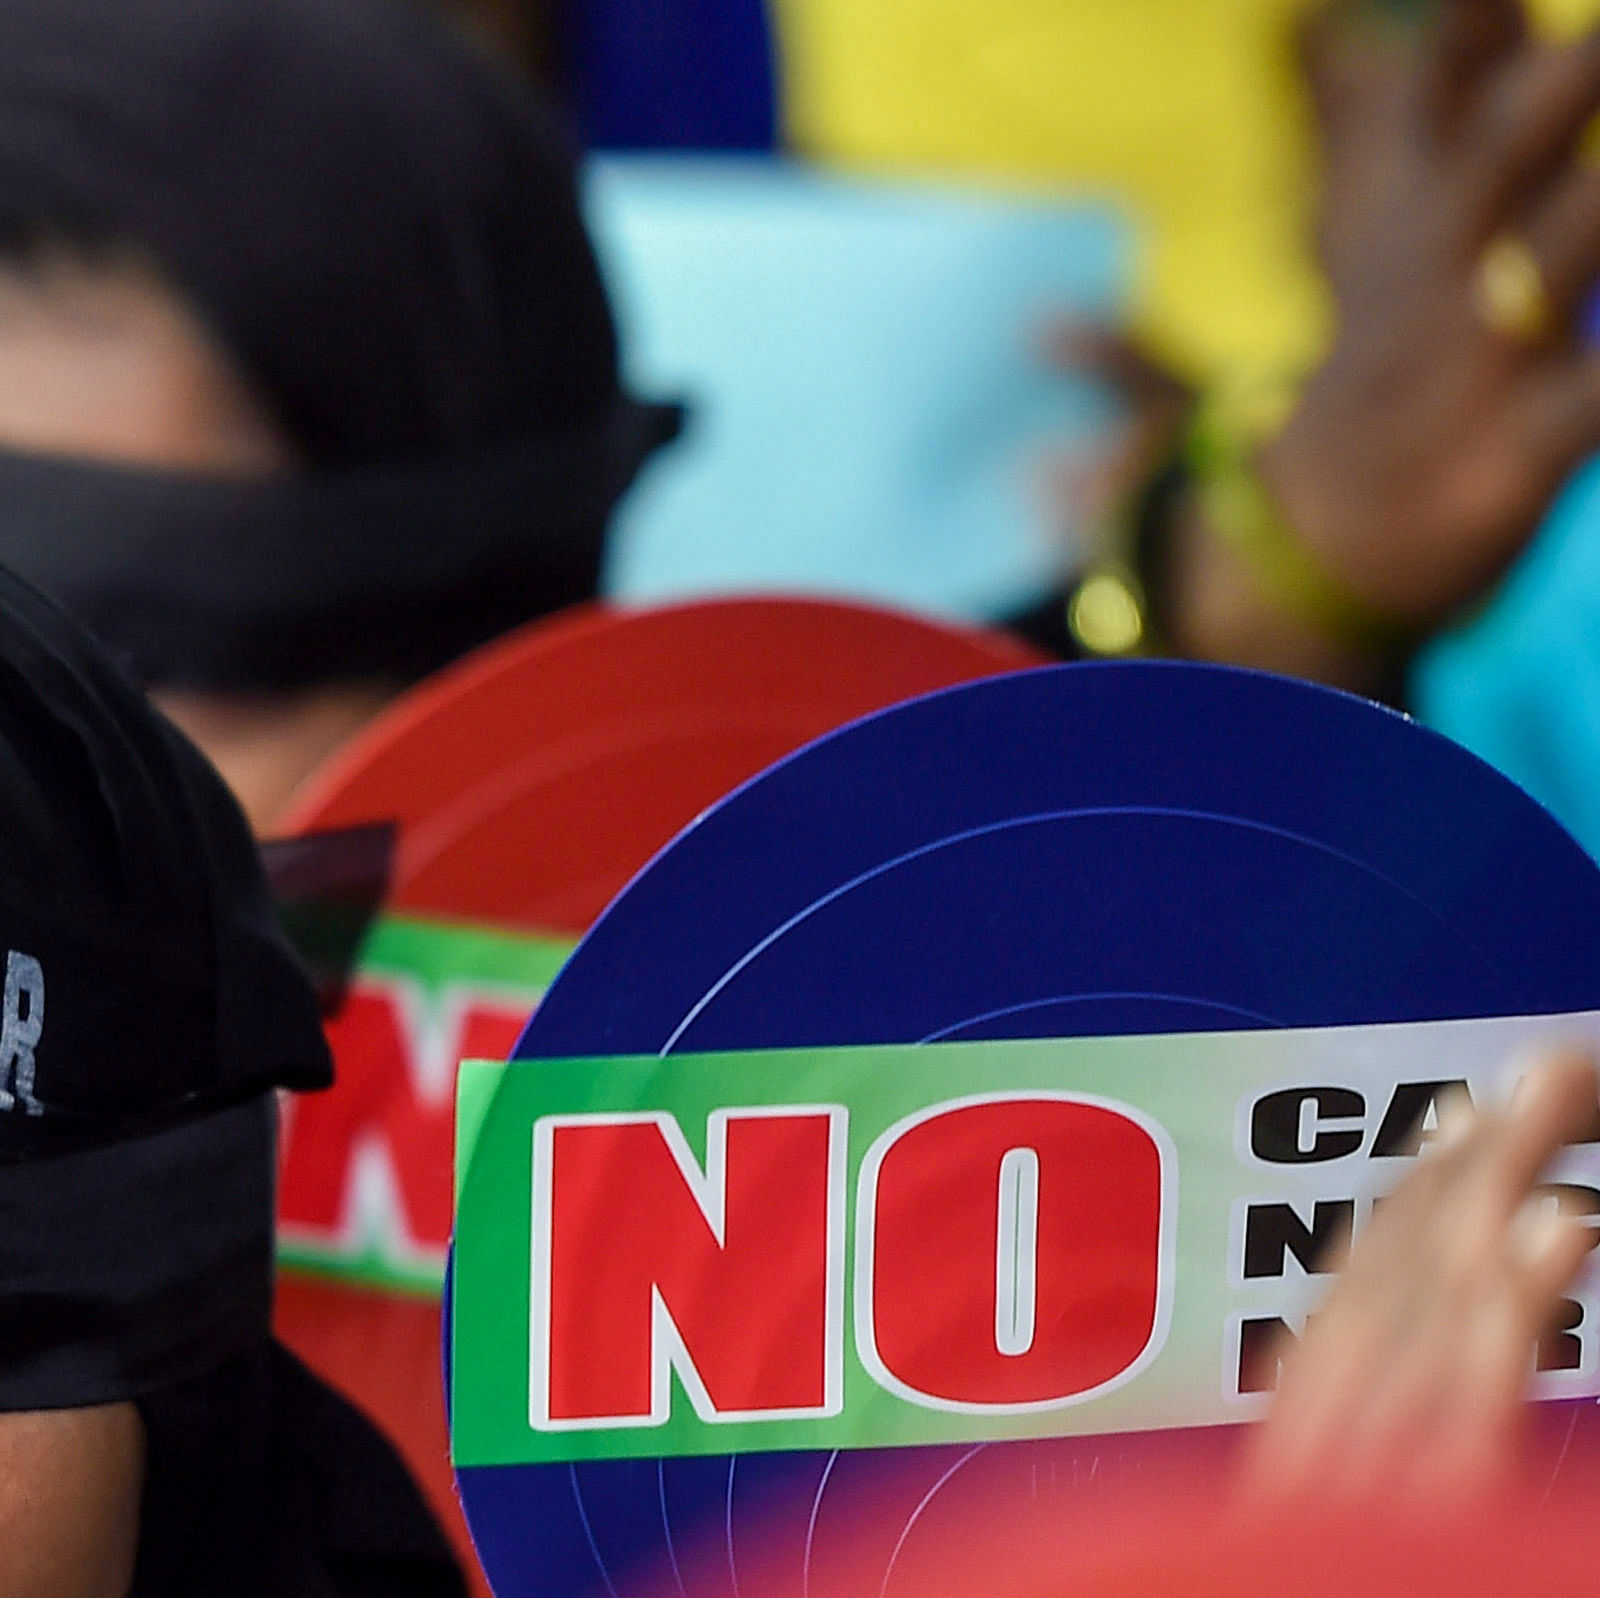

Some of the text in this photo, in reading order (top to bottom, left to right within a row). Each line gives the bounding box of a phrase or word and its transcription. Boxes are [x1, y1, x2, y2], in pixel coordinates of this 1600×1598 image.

[276, 982, 540, 1252] N
[1250, 1077, 1600, 1165] CA
[532, 1090, 1178, 1431] NO
